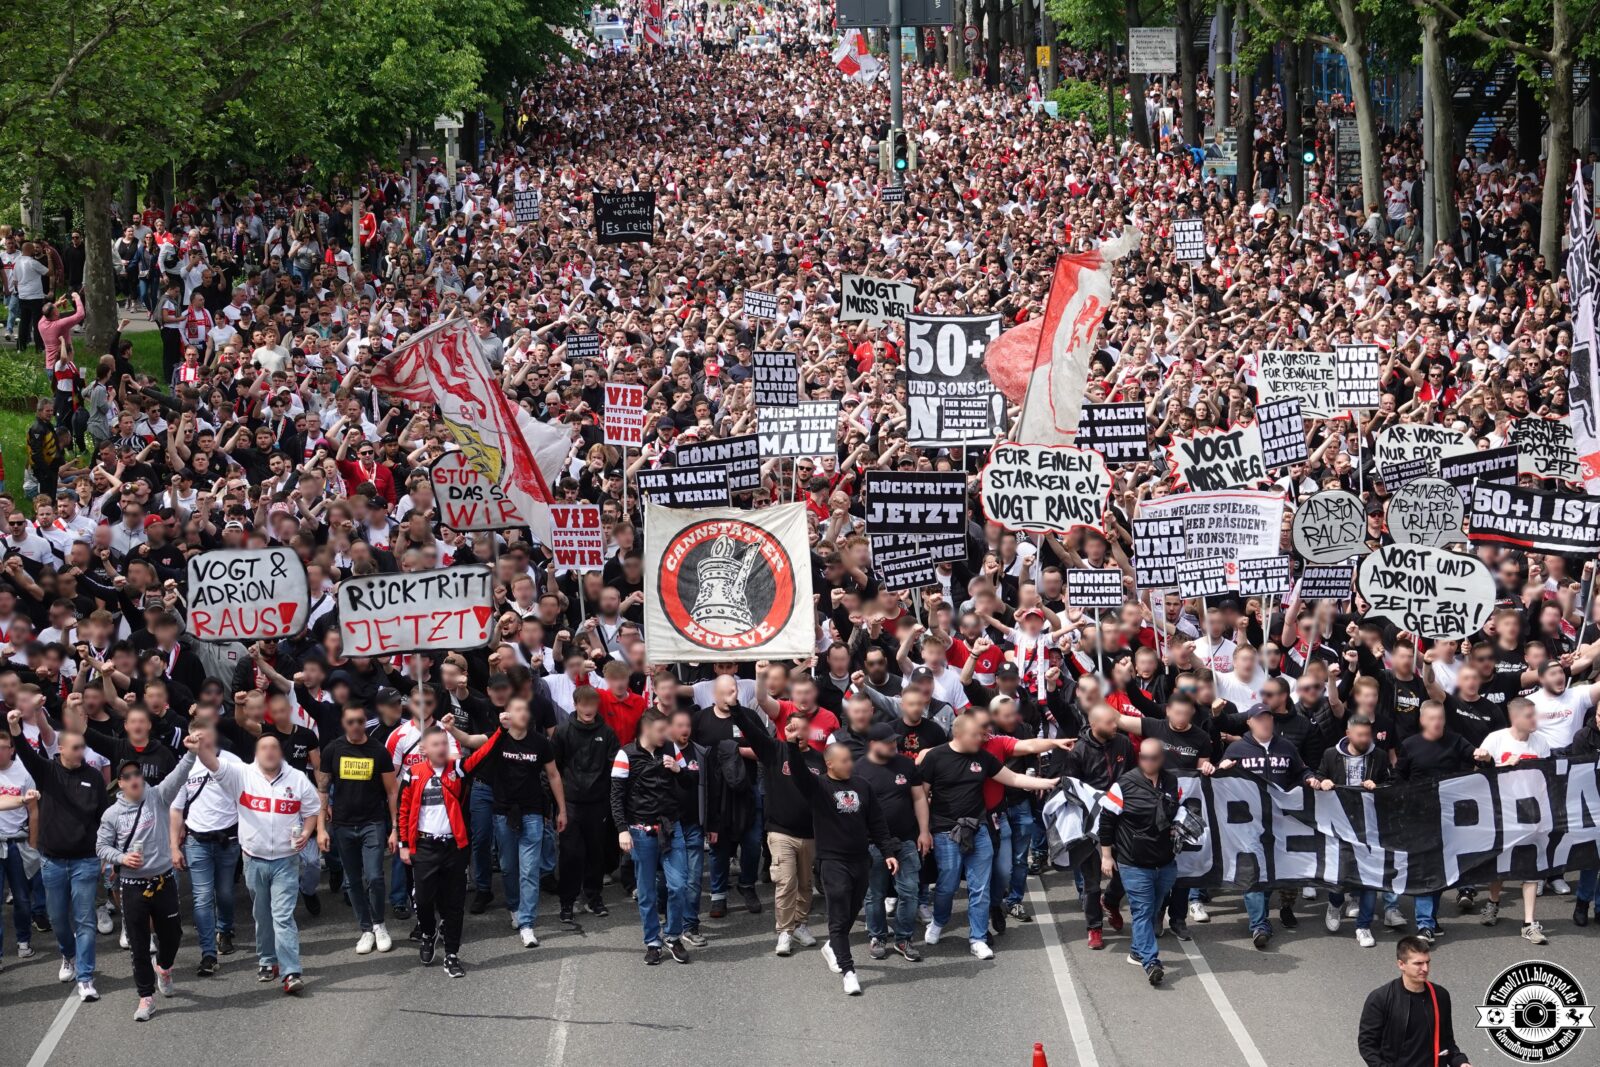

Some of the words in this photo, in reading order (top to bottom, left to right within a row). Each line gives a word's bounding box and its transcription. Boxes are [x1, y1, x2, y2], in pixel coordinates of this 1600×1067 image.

[514, 191, 537, 200] VOGT
[515, 199, 538, 208] UND
[516, 213, 540, 221] RAUS
[1174, 221, 1202, 231] VOGT
[1175, 231, 1203, 242] UND
[1176, 249, 1205, 259] RAUS
[851, 278, 901, 300] VOGT
[744, 305, 777, 318] MAUL
[846, 295, 878, 315] MUSS
[568, 348, 599, 356] KAPUTT
[1337, 347, 1378, 361] VOGT
[753, 353, 796, 367] VOGT
[1261, 353, 1321, 367] AR-VORSITZ
[754, 367, 797, 382] UND
[1263, 367, 1281, 379] FÜR
[1282, 367, 1335, 380] GEWÄHLTE
[1338, 362, 1378, 379] UND
[755, 382, 797, 391] ADRION
[908, 380, 936, 395] UND
[1268, 381, 1330, 393] VERTRETER
[1338, 380, 1378, 390] ADRION
[606, 386, 643, 407] VfB
[755, 391, 798, 405] RAUS
[1338, 391, 1379, 405] RAUS
[606, 407, 643, 415] STUTTGART
[1093, 407, 1145, 421] MACHT
[1257, 399, 1299, 421] VOGT
[606, 415, 621, 424] DAS
[623, 417, 642, 426] SIND
[758, 420, 797, 433] HALT
[800, 419, 837, 431] DEIN
[945, 418, 987, 427] KAPUTT
[1260, 415, 1303, 439] UND
[1510, 417, 1573, 435] VERRATEN
[606, 426, 642, 442] WIR
[1095, 424, 1145, 437] VEREIN
[1388, 427, 1464, 445] AR-VORSITZ
[758, 432, 836, 456] MAUL
[1181, 431, 1243, 465] VOGT
[1263, 432, 1305, 451] ADRION
[678, 440, 758, 466] GÖNNER
[995, 448, 1031, 466] FÜR
[1038, 451, 1092, 472] EINEN
[1265, 444, 1307, 465] RAUS
[1379, 444, 1407, 461] NUR
[1413, 446, 1443, 461] FÜR
[1442, 455, 1517, 480] RÜCKTRITT
[1534, 458, 1581, 475] JETZT
[639, 474, 668, 488] IHR
[672, 470, 726, 486] MACHT
[990, 469, 1070, 491] STARKEN
[1184, 463, 1228, 493] MUSS
[449, 485, 483, 500] DAS
[869, 480, 965, 495] RÜCKTRITT
[674, 488, 728, 503] VEREIN
[867, 502, 964, 524] JETZT
[987, 492, 1039, 521] VOGT
[1045, 494, 1103, 526] RAUS!
[1171, 503, 1210, 517] WELCHE
[1213, 502, 1261, 516] SPIELER,
[1552, 498, 1600, 525] IST
[551, 508, 599, 528] VfB
[1402, 513, 1457, 531] URLAUB
[1133, 520, 1183, 536] VOGT
[1301, 522, 1363, 547] RAUS!
[1472, 513, 1600, 541] UNANTASTBAR!
[873, 535, 894, 548] DU
[1135, 536, 1185, 556] UND
[1197, 533, 1259, 545] KONSTANTE
[666, 522, 784, 572] CANNSTATTER
[1206, 547, 1238, 560] FANS!
[555, 550, 603, 565] WIR
[884, 557, 932, 572] RÜCKTRITT
[1176, 557, 1224, 572] MESCHKE
[1240, 558, 1289, 570] MESCHKE
[1380, 547, 1432, 571] VOGT
[1437, 558, 1475, 577] UND
[192, 558, 261, 582] VOGT
[270, 552, 288, 578] &
[1240, 570, 1264, 579] HALT
[1266, 568, 1289, 577] DEIN
[1304, 568, 1352, 578] GÖNNER
[887, 568, 934, 587] JETZT
[1069, 571, 1121, 584] GÖNNER
[1137, 568, 1176, 585] RAU
[1179, 572, 1201, 582] HALT
[1203, 568, 1225, 578] DEIN
[1369, 565, 1438, 597] ADRION
[1180, 578, 1227, 597] MAUL
[1241, 577, 1290, 594] MAUL
[1301, 589, 1348, 597] SCHLANGE
[1070, 596, 1122, 604] SCHLANGE
[1370, 594, 1430, 613] ZEIT
[1437, 601, 1469, 617] ZU
[191, 602, 298, 637] RAUS!
[1403, 603, 1483, 637] GEHEN!
[345, 605, 492, 652] JETZT!
[684, 621, 776, 648] KURVE
[344, 760, 370, 770] STUTTGART
[1241, 757, 1291, 768] ULTRAS
